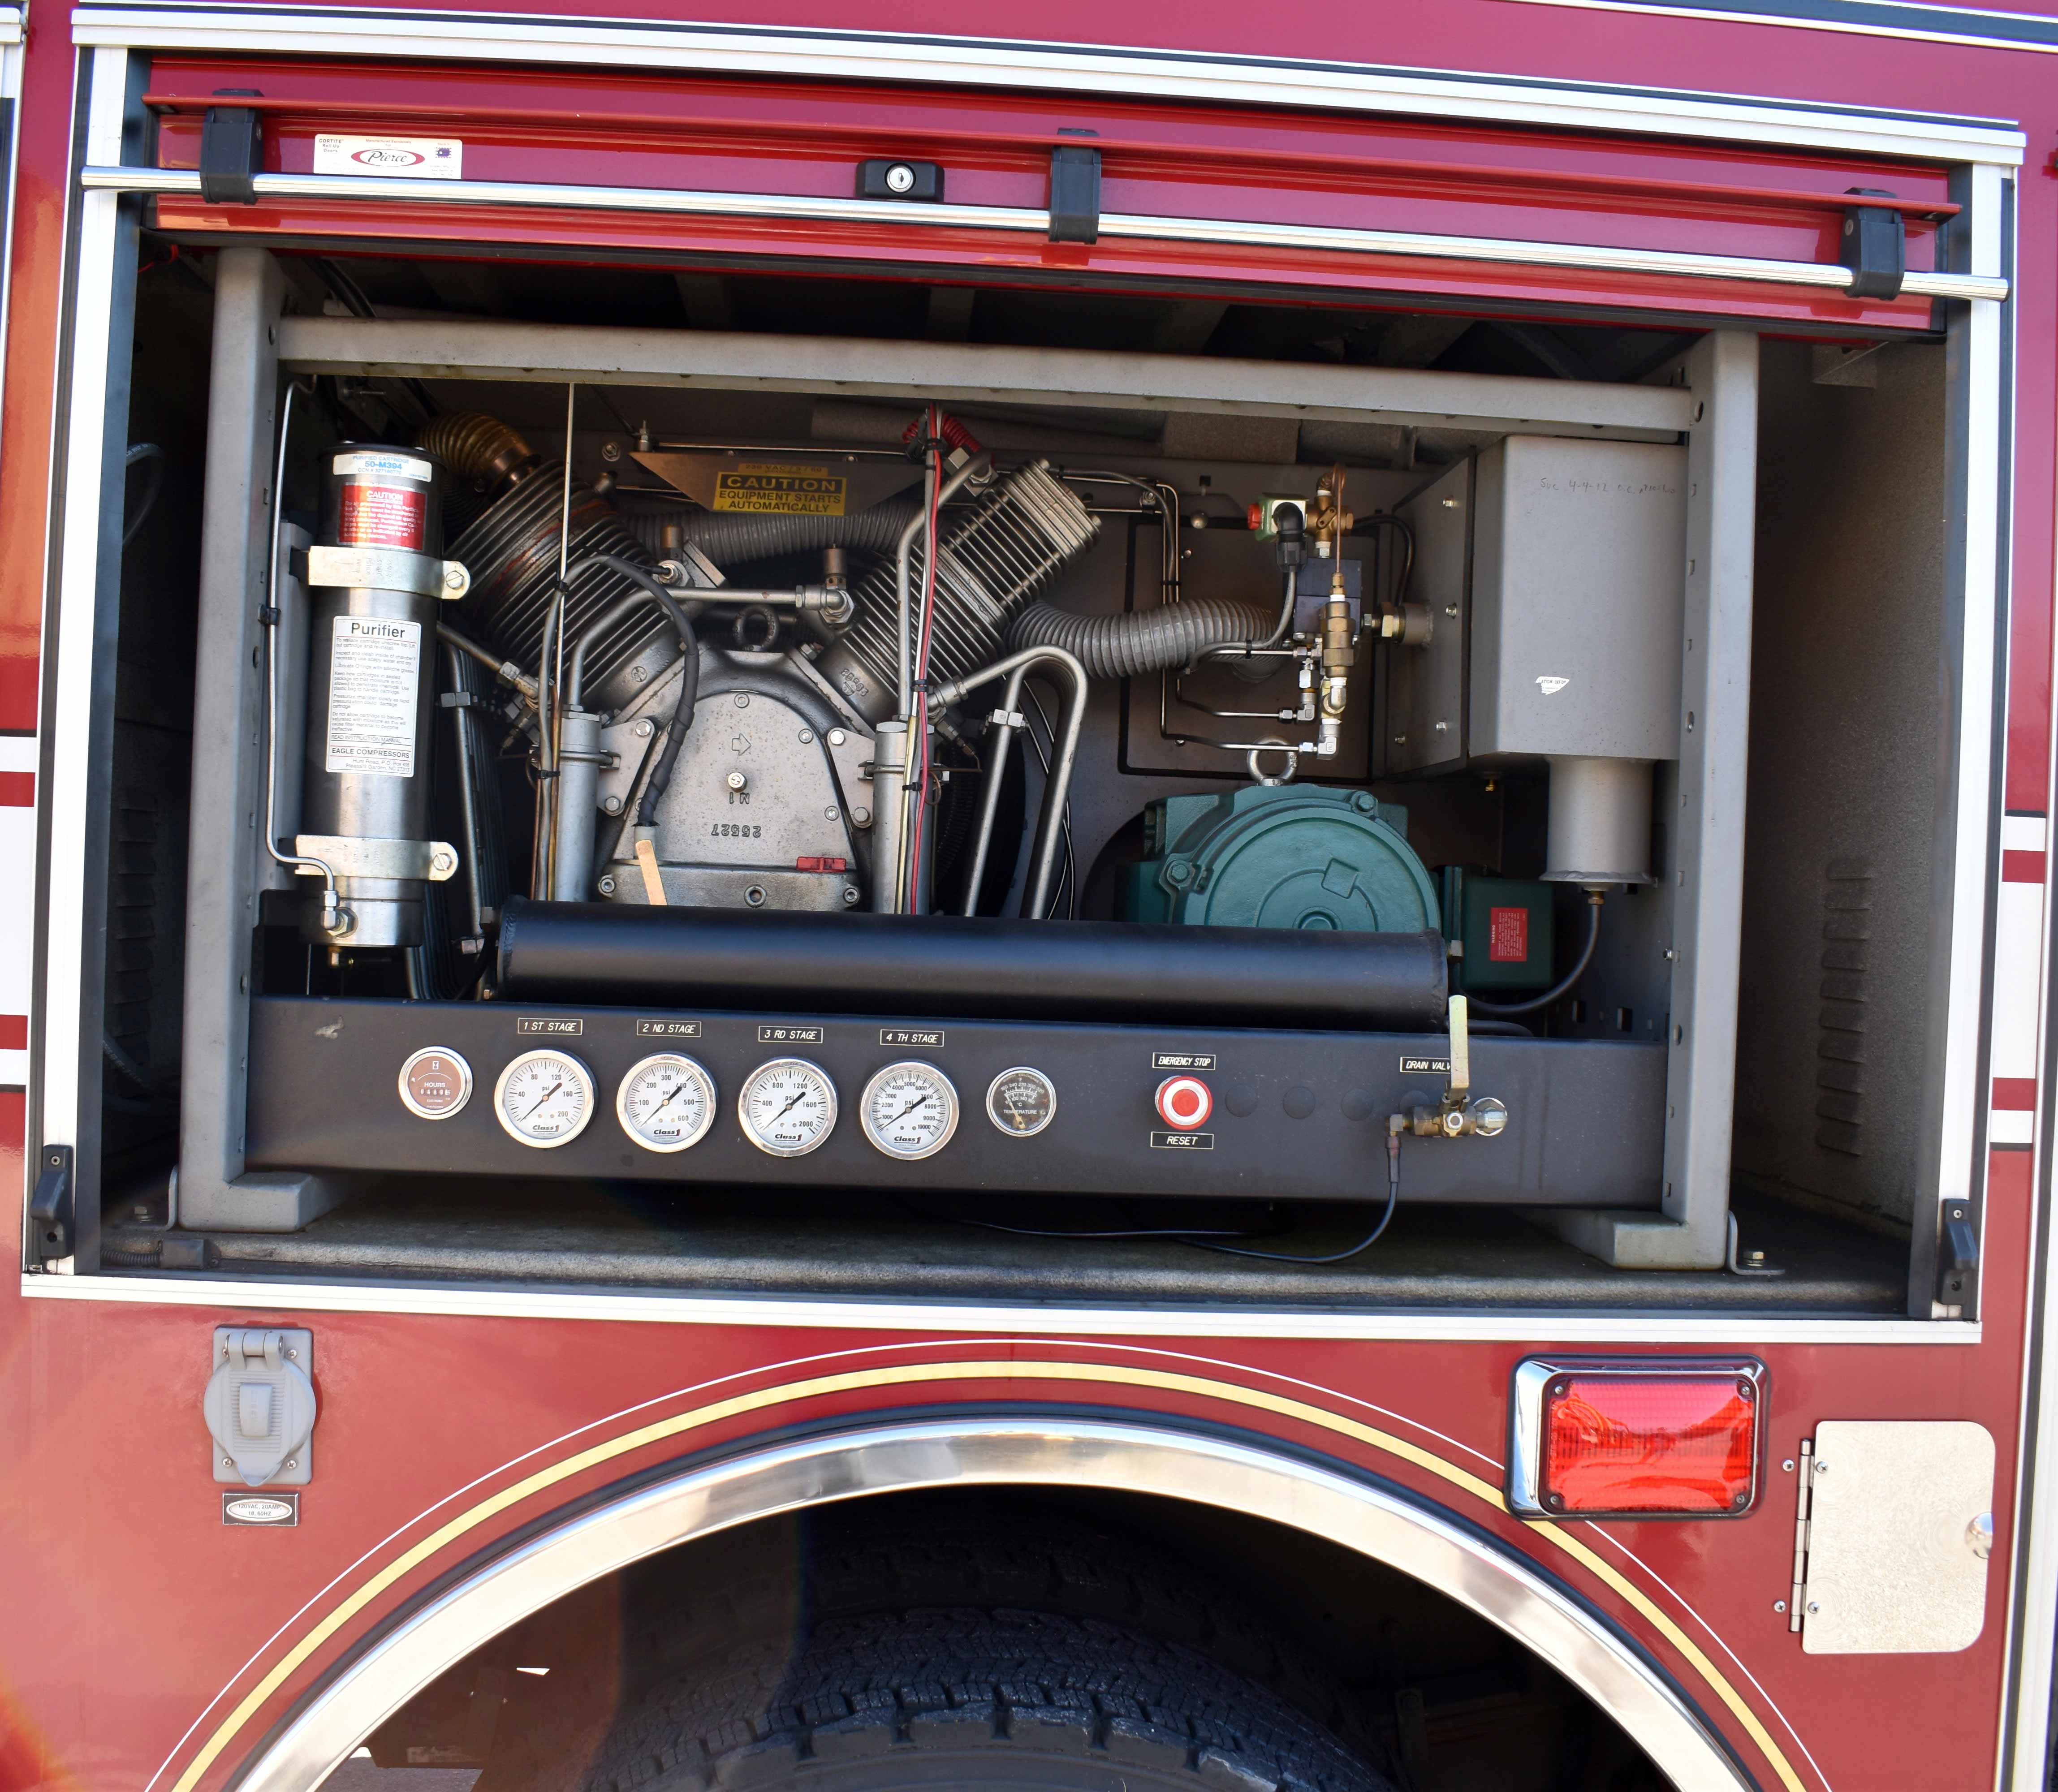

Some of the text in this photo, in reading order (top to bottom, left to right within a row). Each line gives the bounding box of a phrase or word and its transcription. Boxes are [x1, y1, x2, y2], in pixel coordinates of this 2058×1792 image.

[368, 151, 407, 162] Pierce
[365, 461, 402, 470] 50-M394
[727, 477, 836, 491] CAUTION
[367, 491, 403, 502] CAUTION
[719, 490, 841, 504] EQUIPMENT STARTS
[729, 500, 829, 512] AUTOMATICALLY
[351, 623, 405, 638] Purifier
[356, 749, 410, 758] COMPRESSORS
[729, 792, 750, 805] M 1
[711, 823, 762, 838] 25527
[524, 1022, 577, 1031] 1 ST STAGE
[643, 1024, 696, 1034] 2 ND STAGE
[764, 1030, 817, 1039] 3 RD STAGE
[886, 1033, 939, 1043] 4 TH STAGE
[1158, 1056, 1211, 1066] EMERGENCY STOP
[1406, 1060, 1429, 1069] DRAIN
[1166, 1136, 1198, 1145] RESET
